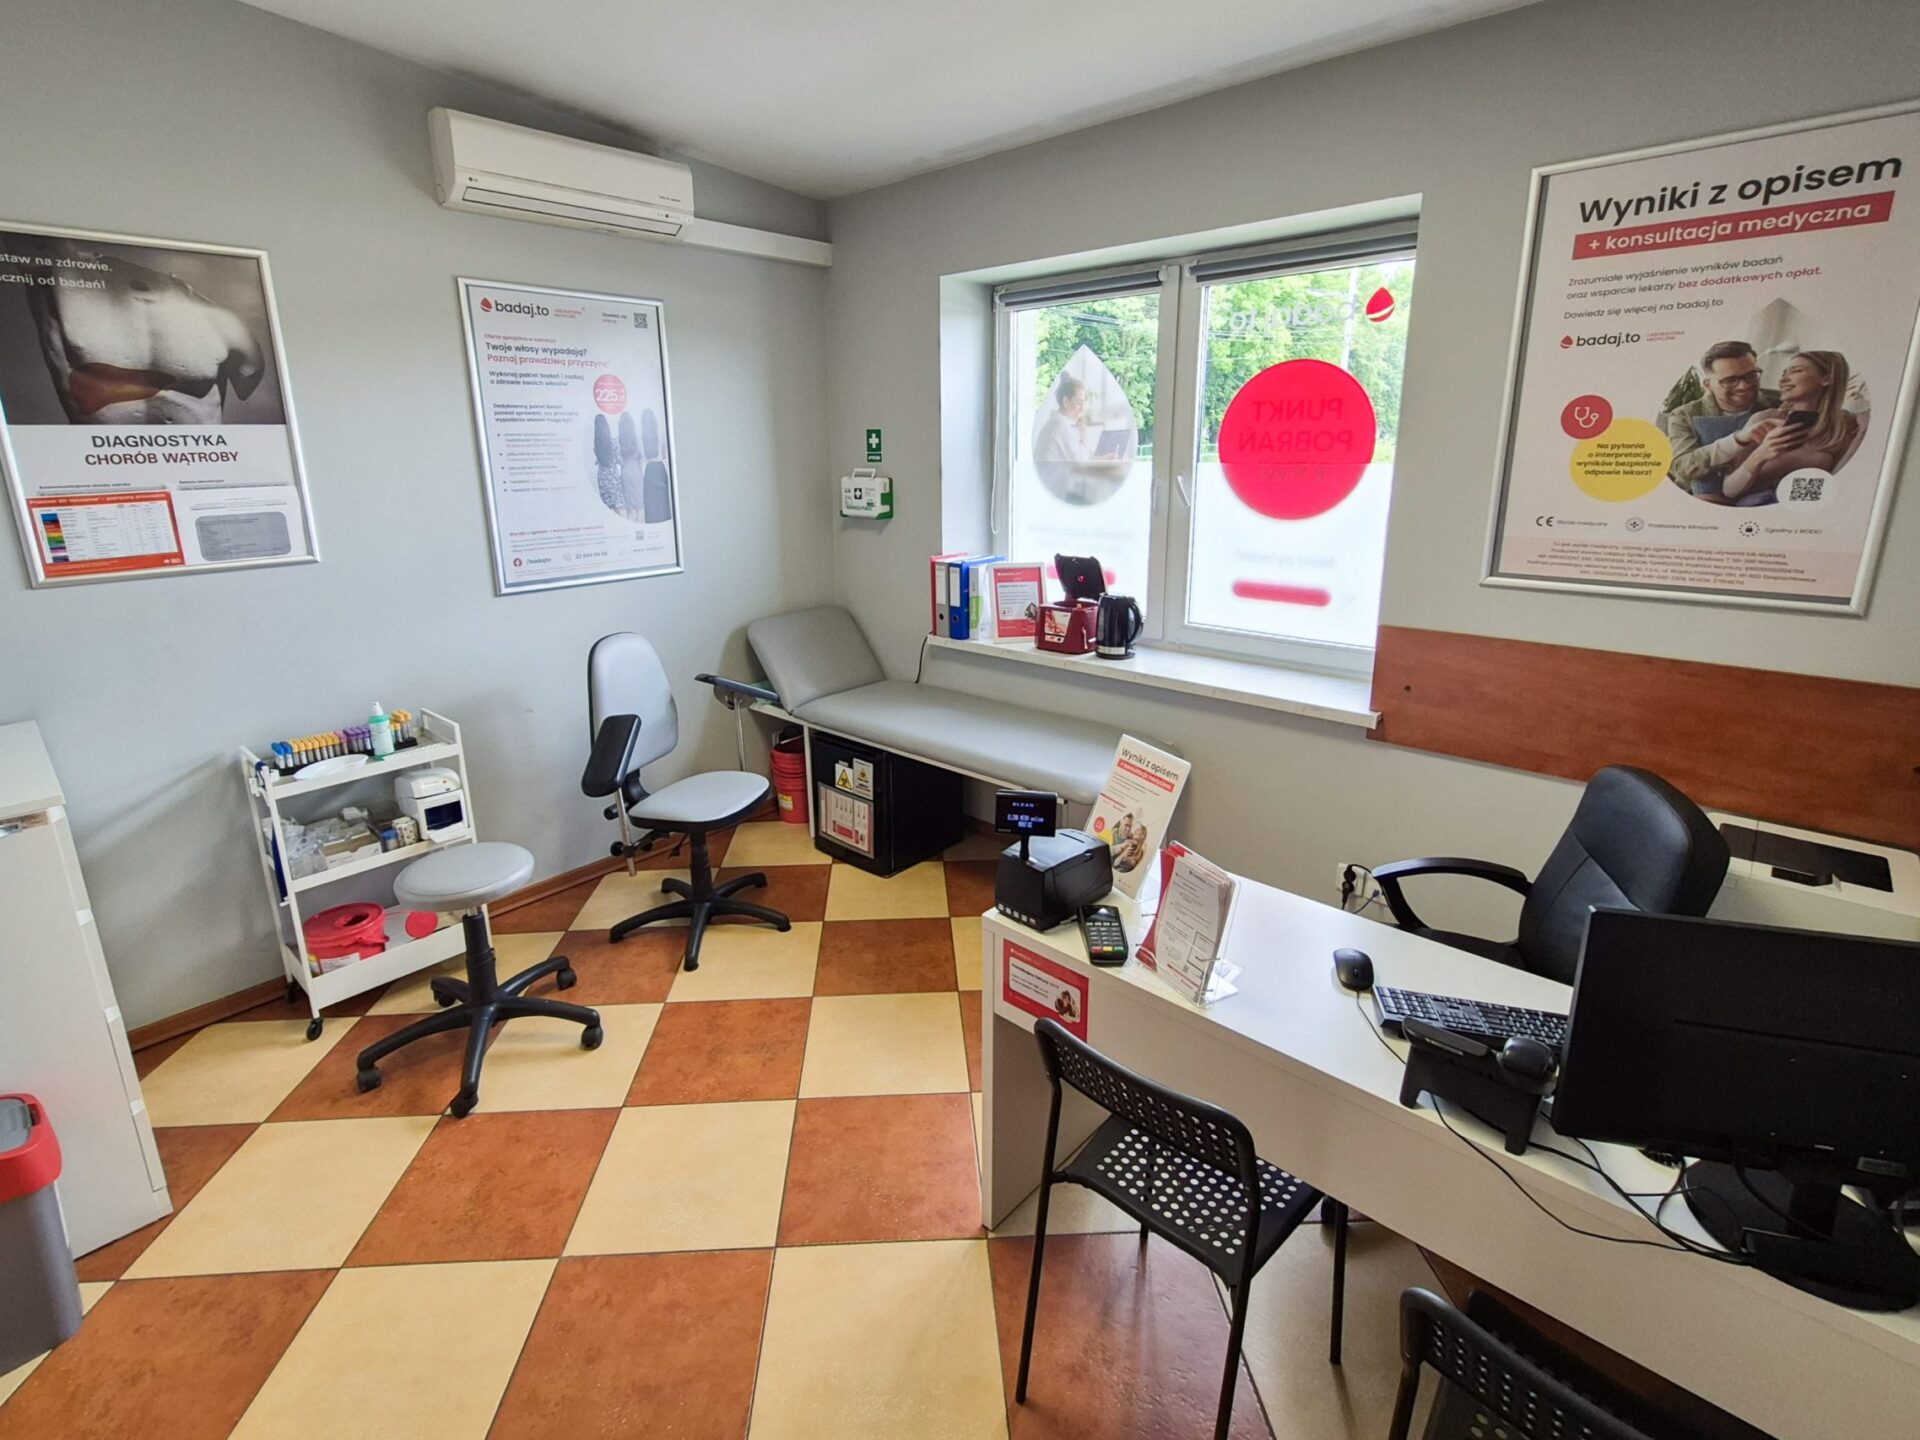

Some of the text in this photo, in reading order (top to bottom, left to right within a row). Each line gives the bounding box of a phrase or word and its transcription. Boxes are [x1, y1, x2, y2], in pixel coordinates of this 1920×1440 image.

[1579, 157, 1903, 226] Wyniki z opisem
[1604, 217, 1731, 251] konsultacja
[1737, 202, 1872, 234] medyczna
[35, 257, 53, 266] na
[56, 258, 113, 271] zdrowie.
[1568, 254, 1783, 287] Zrozumiałe wyjaśnienie wyników badań
[0, 273, 106, 289] cznij od badań!
[1566, 267, 1822, 300] oraz wsparcie lekarzy bez dodatkowych opłat.
[494, 300, 549, 319] badaj.to
[1563, 298, 1724, 320] Dowiedz się więcej na badaj.to
[1576, 332, 1641, 348] badaj.to
[485, 342, 588, 358] Twoje włosy wypadają?
[487, 353, 518, 365] Poznaj
[519, 356, 566, 366] prawdziwą
[91, 434, 228, 449] DIAGNOSTYKA
[1610, 442, 1645, 451] pytania
[85, 450, 239, 466] CHORÓB WĄTROBY
[1595, 451, 1652, 459] interpretację
[1576, 460, 1662, 468] wyników bezpłatnie
[1584, 468, 1621, 476] odpowie
[1121, 747, 1147, 766] Wyniki
[1150, 763, 1180, 781] opisem
